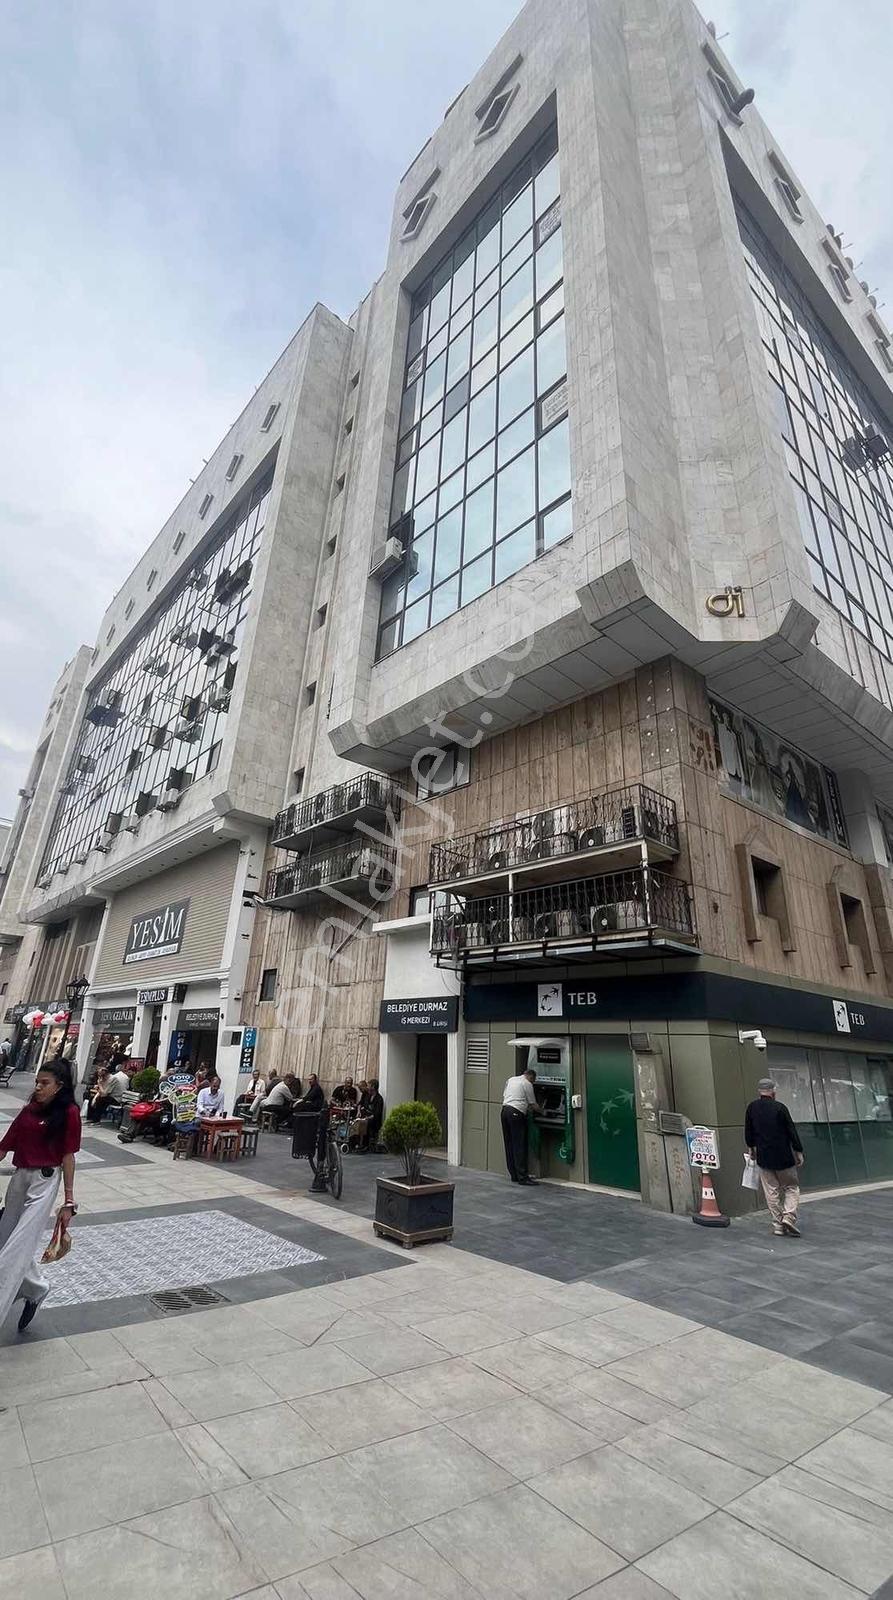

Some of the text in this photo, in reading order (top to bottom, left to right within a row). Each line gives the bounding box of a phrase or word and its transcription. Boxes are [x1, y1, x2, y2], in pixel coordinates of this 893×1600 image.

[568, 992, 597, 1006] TEB
[386, 1000, 448, 1013] BELEDİYE DURMAZ
[850, 1012, 865, 1026] TEB
[691, 1152, 716, 1162] FOTO
